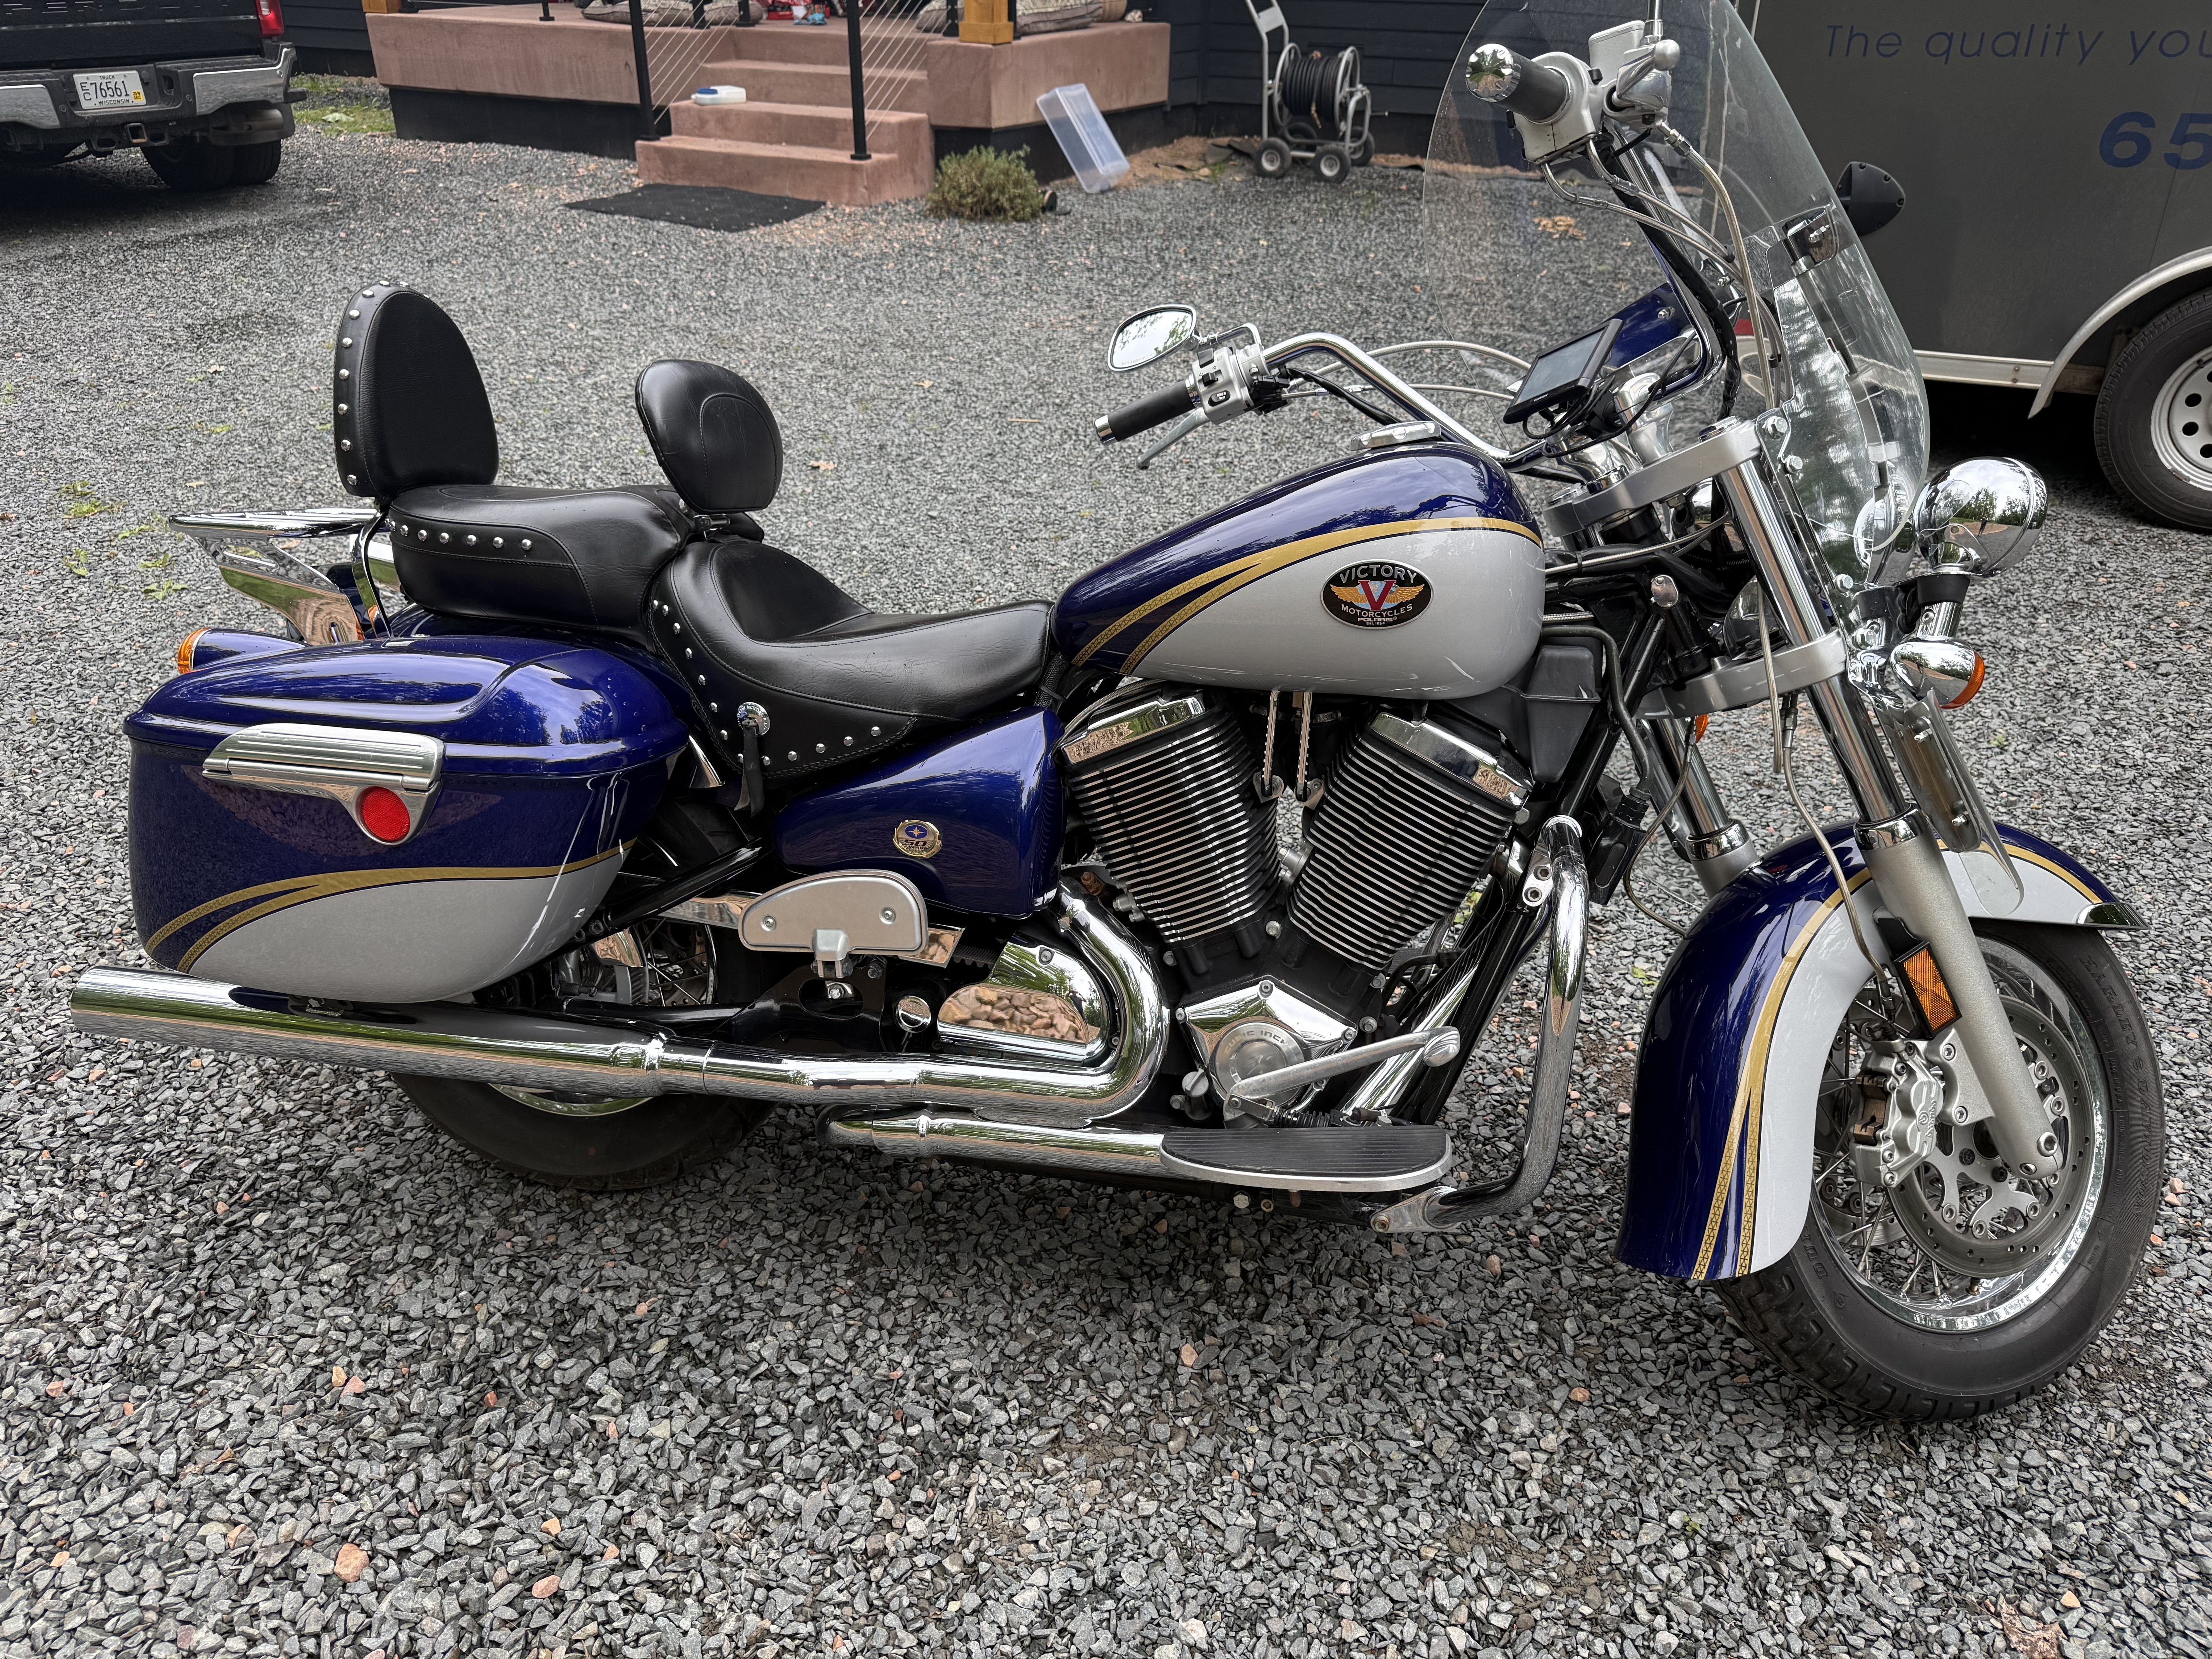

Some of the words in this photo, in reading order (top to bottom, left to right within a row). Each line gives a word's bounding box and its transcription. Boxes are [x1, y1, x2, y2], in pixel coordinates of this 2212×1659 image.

[1827, 25, 1902, 58] The
[1925, 24, 2104, 65] quality
[90, 81, 130, 99] 76561
[2099, 111, 2212, 170] 65
[1340, 565, 1417, 583] VICTORY
[1358, 580, 1396, 611] V
[1341, 603, 1413, 617] MOTORCYCLES
[1224, 1030, 1255, 1054] CUBIC
[2079, 954, 2138, 1047] HARLEY
[2133, 1078, 2152, 1219] DAVIDSON
[2114, 1087, 2123, 1104] USA
